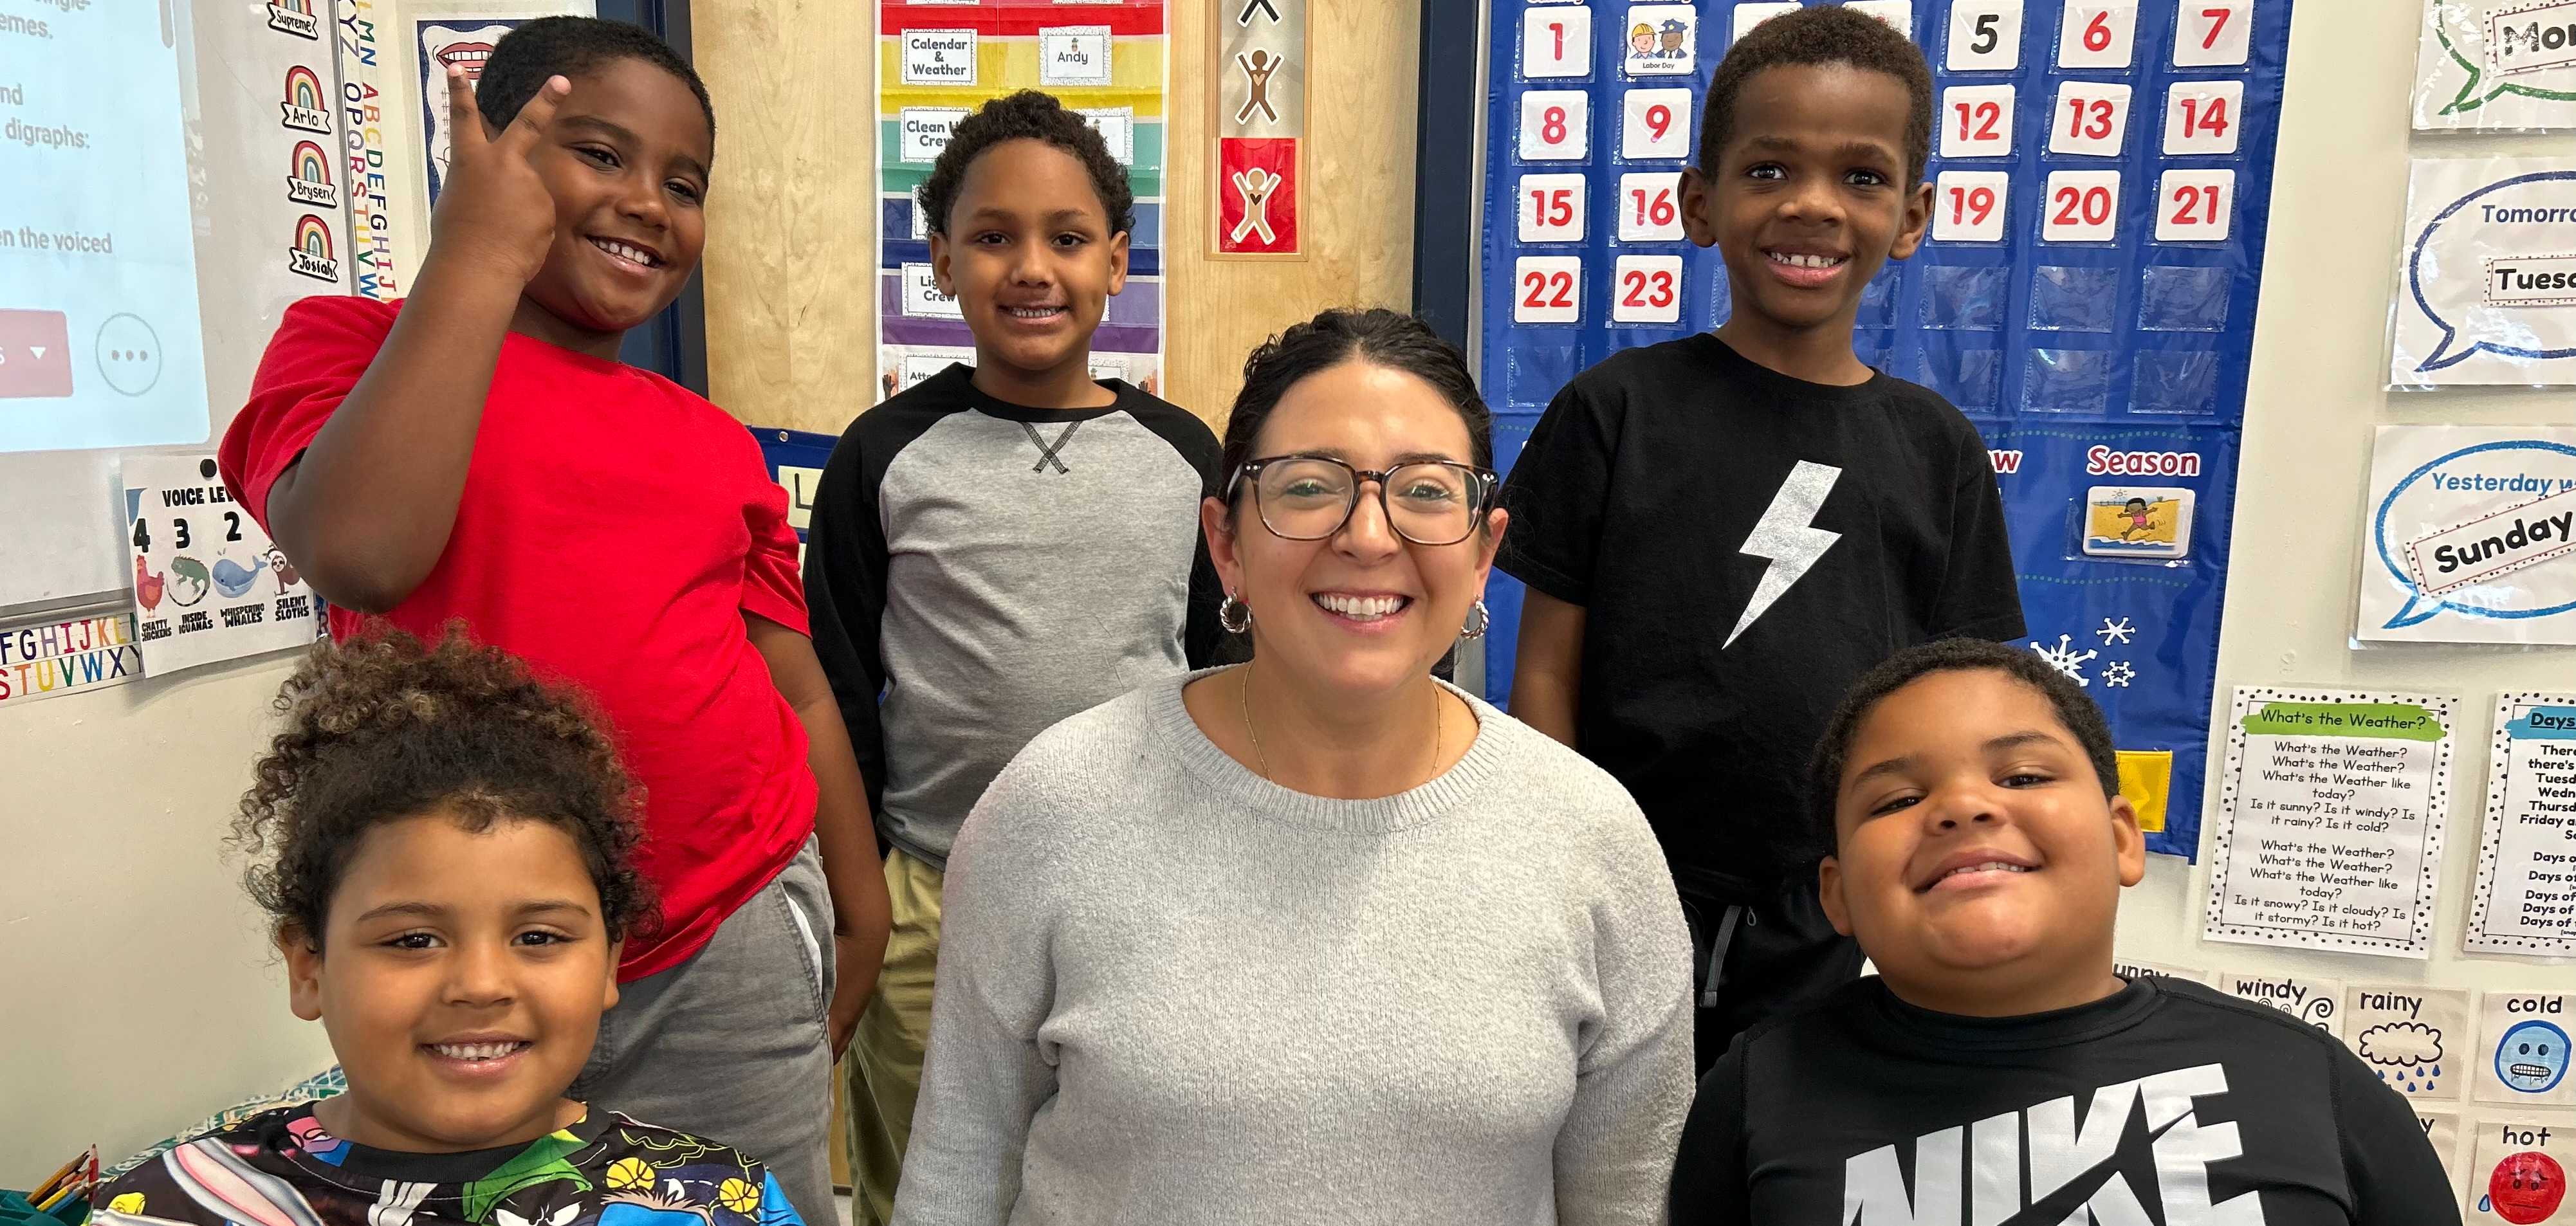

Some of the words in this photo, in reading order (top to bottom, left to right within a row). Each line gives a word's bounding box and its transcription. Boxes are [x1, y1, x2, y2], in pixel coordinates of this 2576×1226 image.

[277, 10, 312, 33] Supreme
[2083, 11, 2111, 51] 6
[2202, 8, 2231, 49] 7
[911, 38, 968, 50] Calendar
[1549, 23, 1563, 60] 1
[1971, 14, 1999, 54] 5
[934, 51, 944, 62] &
[1057, 51, 1089, 65] Andy
[912, 64, 966, 76] Weather
[293, 110, 319, 127] Arlo
[906, 120, 945, 133] Clean
[1542, 106, 1567, 145] 8
[1646, 104, 1671, 143] 9
[1955, 102, 2000, 142] 12
[2069, 98, 2114, 140] 13
[2180, 97, 2229, 138] 14
[5, 117, 90, 149] digraphs:
[919, 134, 947, 147] Cre
[297, 181, 331, 201] Brysen
[1531, 190, 1573, 227] 15
[1632, 188, 1675, 226] 16
[1949, 187, 1995, 226] 19
[2052, 187, 2111, 226] 20
[2171, 186, 2220, 225] 21
[19, 226, 50, 250] the
[53, 232, 112, 254] voiced
[299, 254, 333, 277] Josiah
[1523, 271, 1573, 307] 22
[1622, 271, 1674, 307] 23
[2088, 448, 2198, 475] Season
[2433, 473, 2553, 497] Yesterday
[2559, 479, 2576, 491] w
[162, 488, 205, 507] VOICE
[133, 518, 150, 553] 4
[174, 518, 190, 549] 3
[224, 511, 242, 542] 2
[2434, 511, 2573, 573] Sunday
[276, 595, 307, 610] SILENT
[181, 610, 208, 624] INSIDE
[225, 612, 262, 628] WHALES
[275, 605, 309, 621] SLOTHS
[142, 619, 167, 632] CHATTY
[179, 619, 214, 634] IGUANAS
[2261, 709, 2313, 724] What's
[2319, 712, 2342, 725] the
[2350, 713, 2426, 729] Weather?
[2531, 713, 2575, 730] Days
[2275, 741, 2317, 753] What's
[2321, 744, 2340, 755] the
[2346, 745, 2407, 758] Weather?
[2272, 756, 2314, 768] What's
[2319, 758, 2337, 769] the
[2343, 760, 2405, 773] Weather?
[2528, 758, 2575, 770] there's
[2263, 770, 2304, 782] What's
[2309, 773, 2328, 783] the
[2333, 774, 2387, 787] Weather
[2392, 778, 2411, 789] like
[2312, 788, 2355, 802] today?
[2538, 787, 2575, 798] Wedn
[2250, 798, 2263, 809] Is
[2267, 800, 2276, 809] it
[2280, 802, 2321, 814] sunny?
[2324, 803, 2337, 814] Is
[2342, 805, 2351, 814] it
[2355, 807, 2398, 820] windy?
[2402, 809, 2415, 820] Is
[2272, 816, 2280, 825] it
[2285, 817, 2322, 829] rainy?
[2326, 818, 2339, 828] Is
[2343, 820, 2352, 830] it
[2357, 821, 2389, 832] cold?
[2520, 814, 2564, 828] Friday
[2261, 839, 2303, 852] What's
[2307, 843, 2326, 854] the
[2332, 845, 2395, 859] Weather?
[2534, 852, 2566, 865] Days
[2259, 854, 2301, 866] What's
[2306, 857, 2324, 868] the
[2330, 857, 2392, 874] Weather?
[2250, 867, 2291, 880] What's
[2296, 872, 2315, 882] the
[2321, 873, 2375, 887] Weather
[2379, 878, 2398, 889] like
[2528, 871, 2561, 883] Days
[2299, 886, 2342, 900] today?
[2525, 890, 2558, 902] Days
[2234, 895, 2247, 905] Is
[2251, 897, 2259, 906] it
[2264, 900, 2308, 911] snowy?
[2312, 901, 2324, 911] Is
[2329, 904, 2338, 913] it
[2342, 904, 2388, 919] cloudy?
[2392, 908, 2406, 919] Is
[2523, 903, 2555, 915] Days
[2559, 905, 2574, 914] of
[2255, 911, 2263, 920] it
[2268, 913, 2318, 927] stormy?
[2322, 916, 2335, 927] Is
[2339, 919, 2348, 928] it
[2352, 919, 2380, 931] hot?
[2520, 916, 2553, 929] Days
[2557, 918, 2572, 927] of
[2236, 978, 2307, 1005] windy
[2360, 991, 2422, 1020] rainy
[2507, 996, 2563, 1014] cold
[1843, 1062, 2265, 1226] NIKE
[2503, 1126, 2552, 1147] hot
